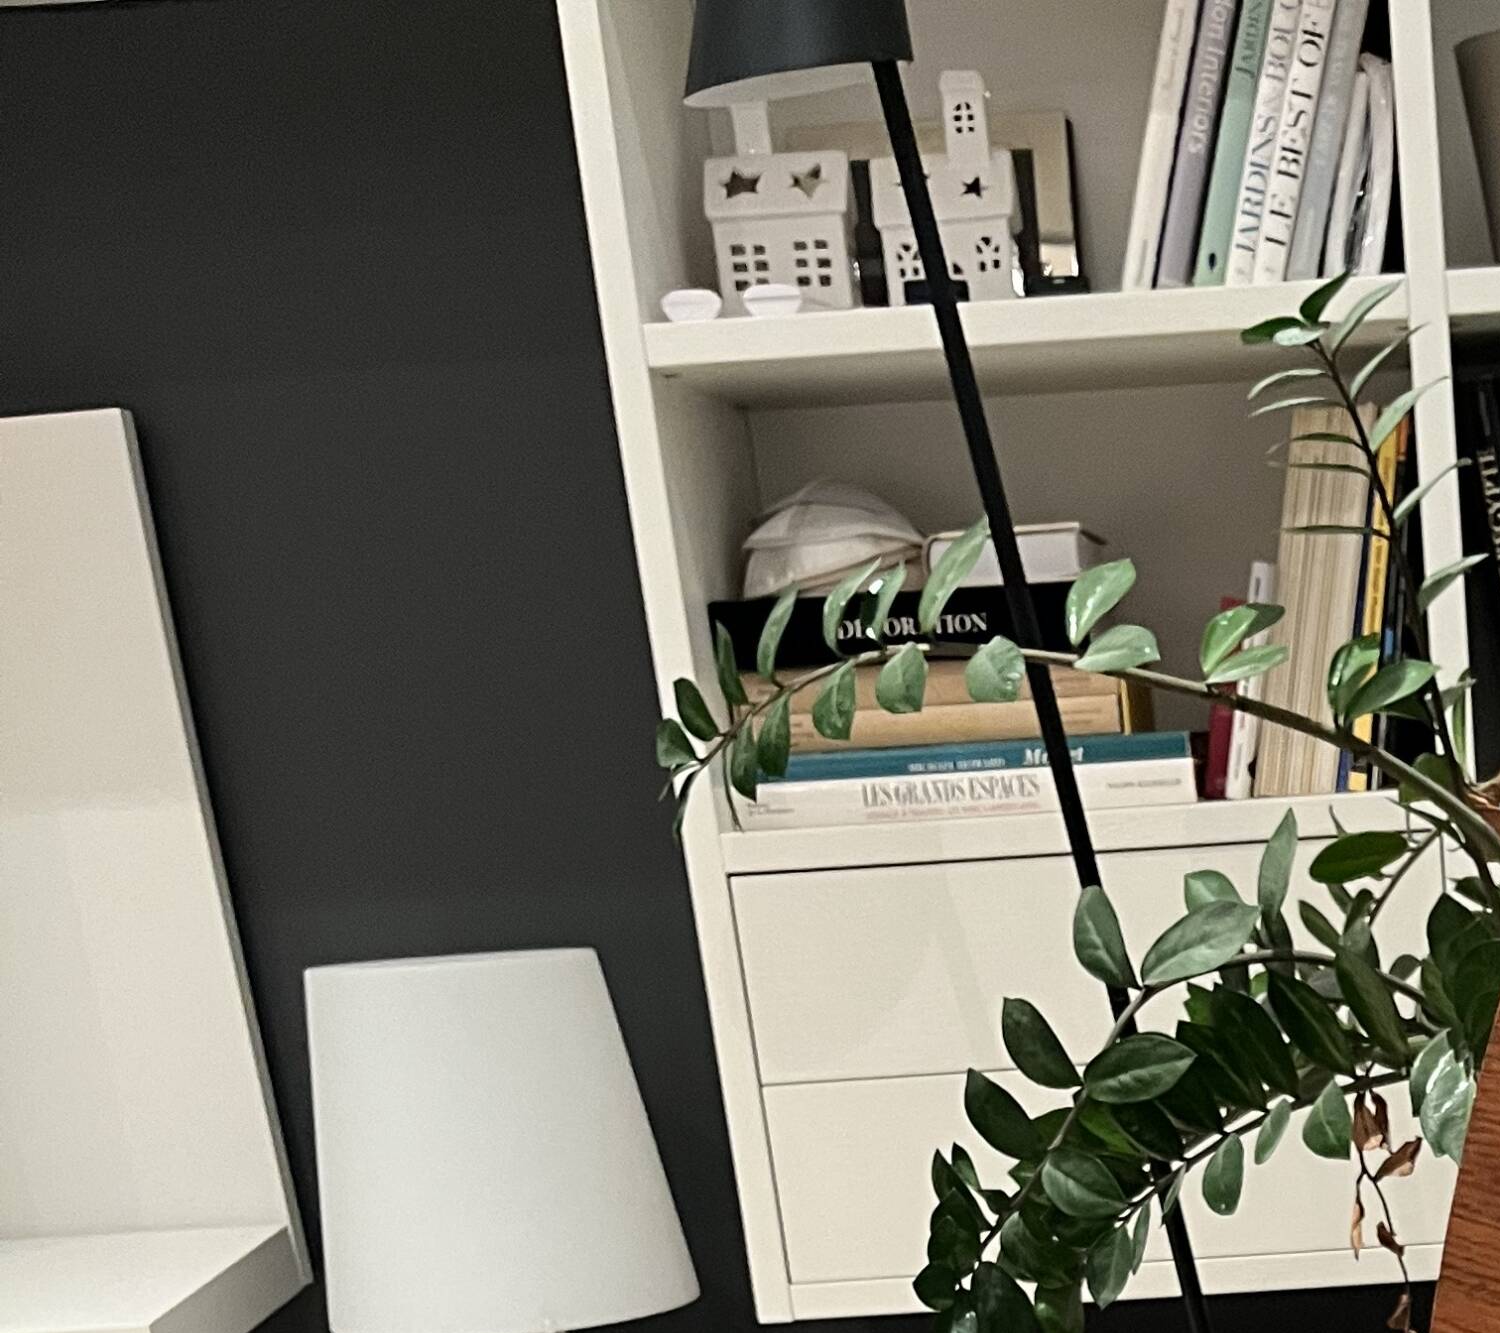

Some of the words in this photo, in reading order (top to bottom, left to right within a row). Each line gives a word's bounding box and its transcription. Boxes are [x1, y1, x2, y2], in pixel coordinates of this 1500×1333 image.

[1298, 13, 1326, 67] OF
[1190, 47, 1226, 154] Interiors
[1277, 78, 1313, 179] BEST
[1234, 113, 1276, 252] JARDINS
[1265, 192, 1294, 247] LE
[838, 612, 987, 640] DORTION
[862, 783, 894, 807] LES
[968, 773, 1041, 801] ESPACES
